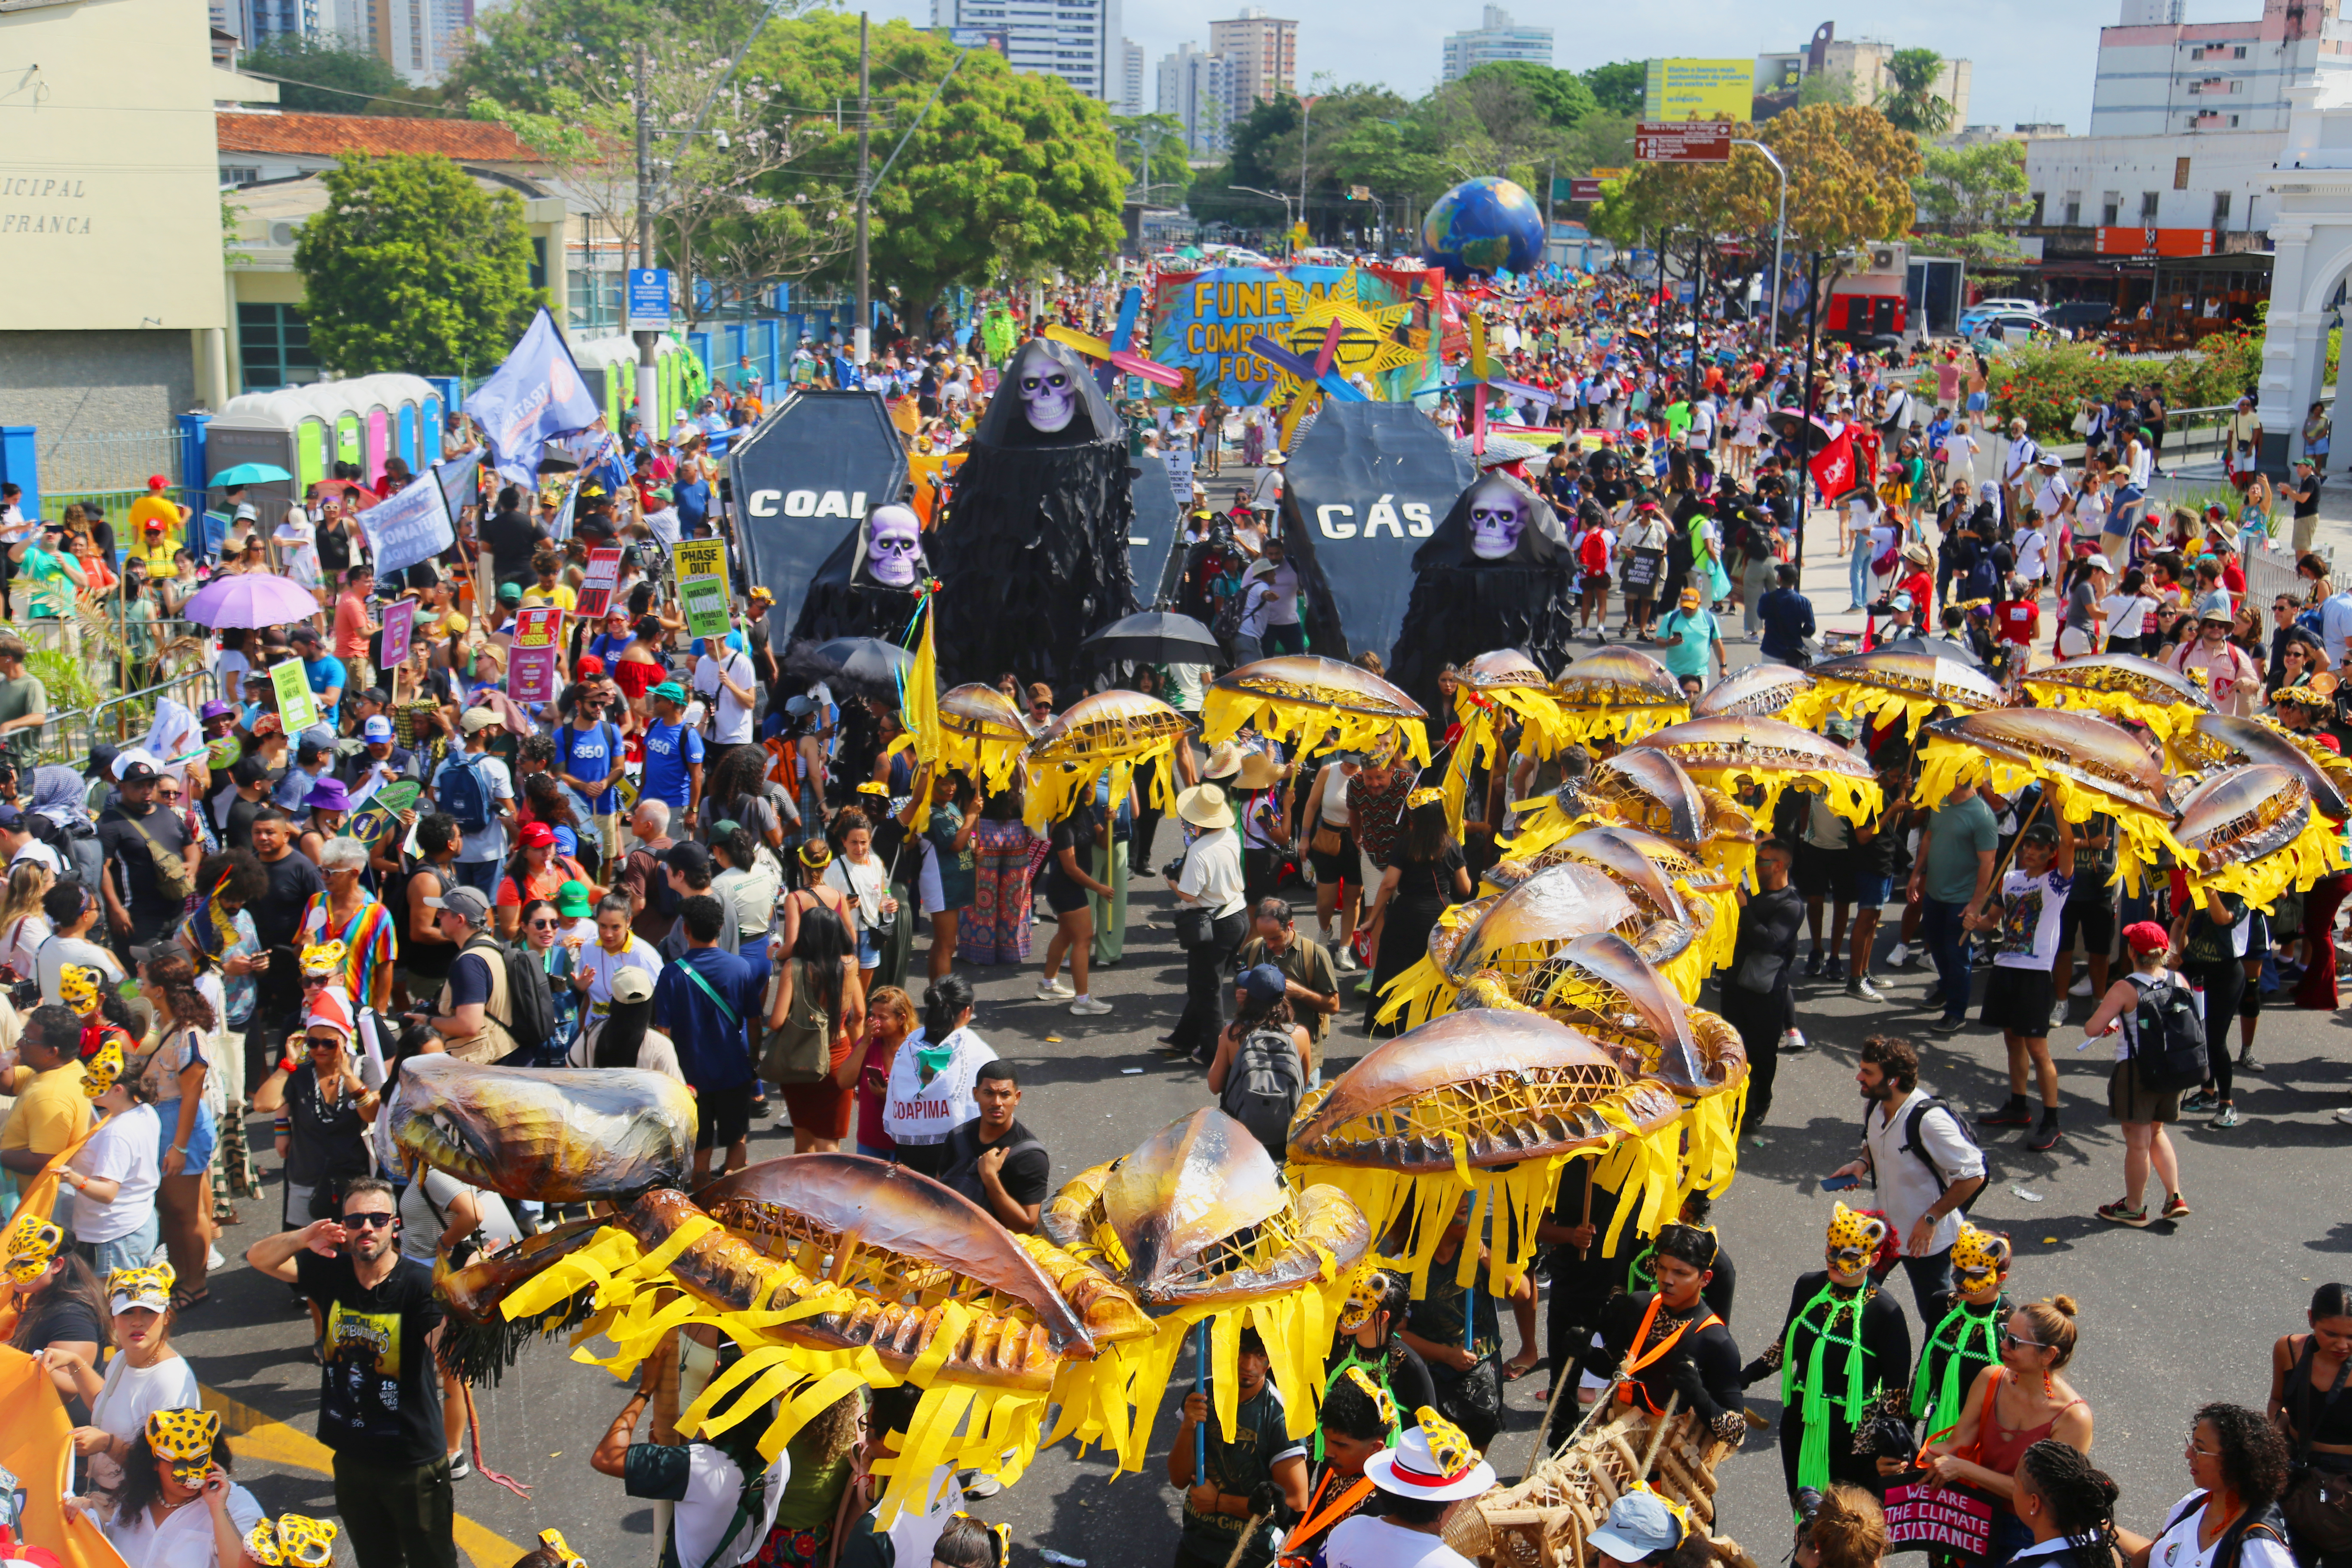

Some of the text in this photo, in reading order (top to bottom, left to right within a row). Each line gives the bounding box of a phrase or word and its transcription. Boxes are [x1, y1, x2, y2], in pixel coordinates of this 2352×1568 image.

[0, 178, 85, 198] ICIPAL
[2, 214, 90, 234] FRANCA
[749, 490, 868, 520] COAL
[1316, 493, 1435, 539] GÁS
[673, 542, 686, 550] FAST
[699, 539, 723, 548] FOREVER
[681, 549, 718, 563] PHASE
[586, 560, 617, 578] MAKE
[689, 562, 711, 574] OUT
[1627, 568, 1648, 578] BEFORE
[1634, 564, 1651, 572] DYING
[1628, 576, 1651, 585] ARRIVES
[687, 586, 717, 599] AMAZÔNIA
[577, 591, 607, 614] PAY
[689, 595, 721, 614] LIVRE
[530, 611, 548, 623] END
[529, 622, 546, 634] THE
[520, 634, 549, 646] FOSSIL
[357, 817, 370, 832] SEM
[893, 1099, 950, 1120] COAPIMA
[1906, 1485, 1968, 1510] WE ARE
[1884, 1503, 1989, 1536] THE CLIMATE
[1885, 1521, 1983, 1555] RESISTANCE
